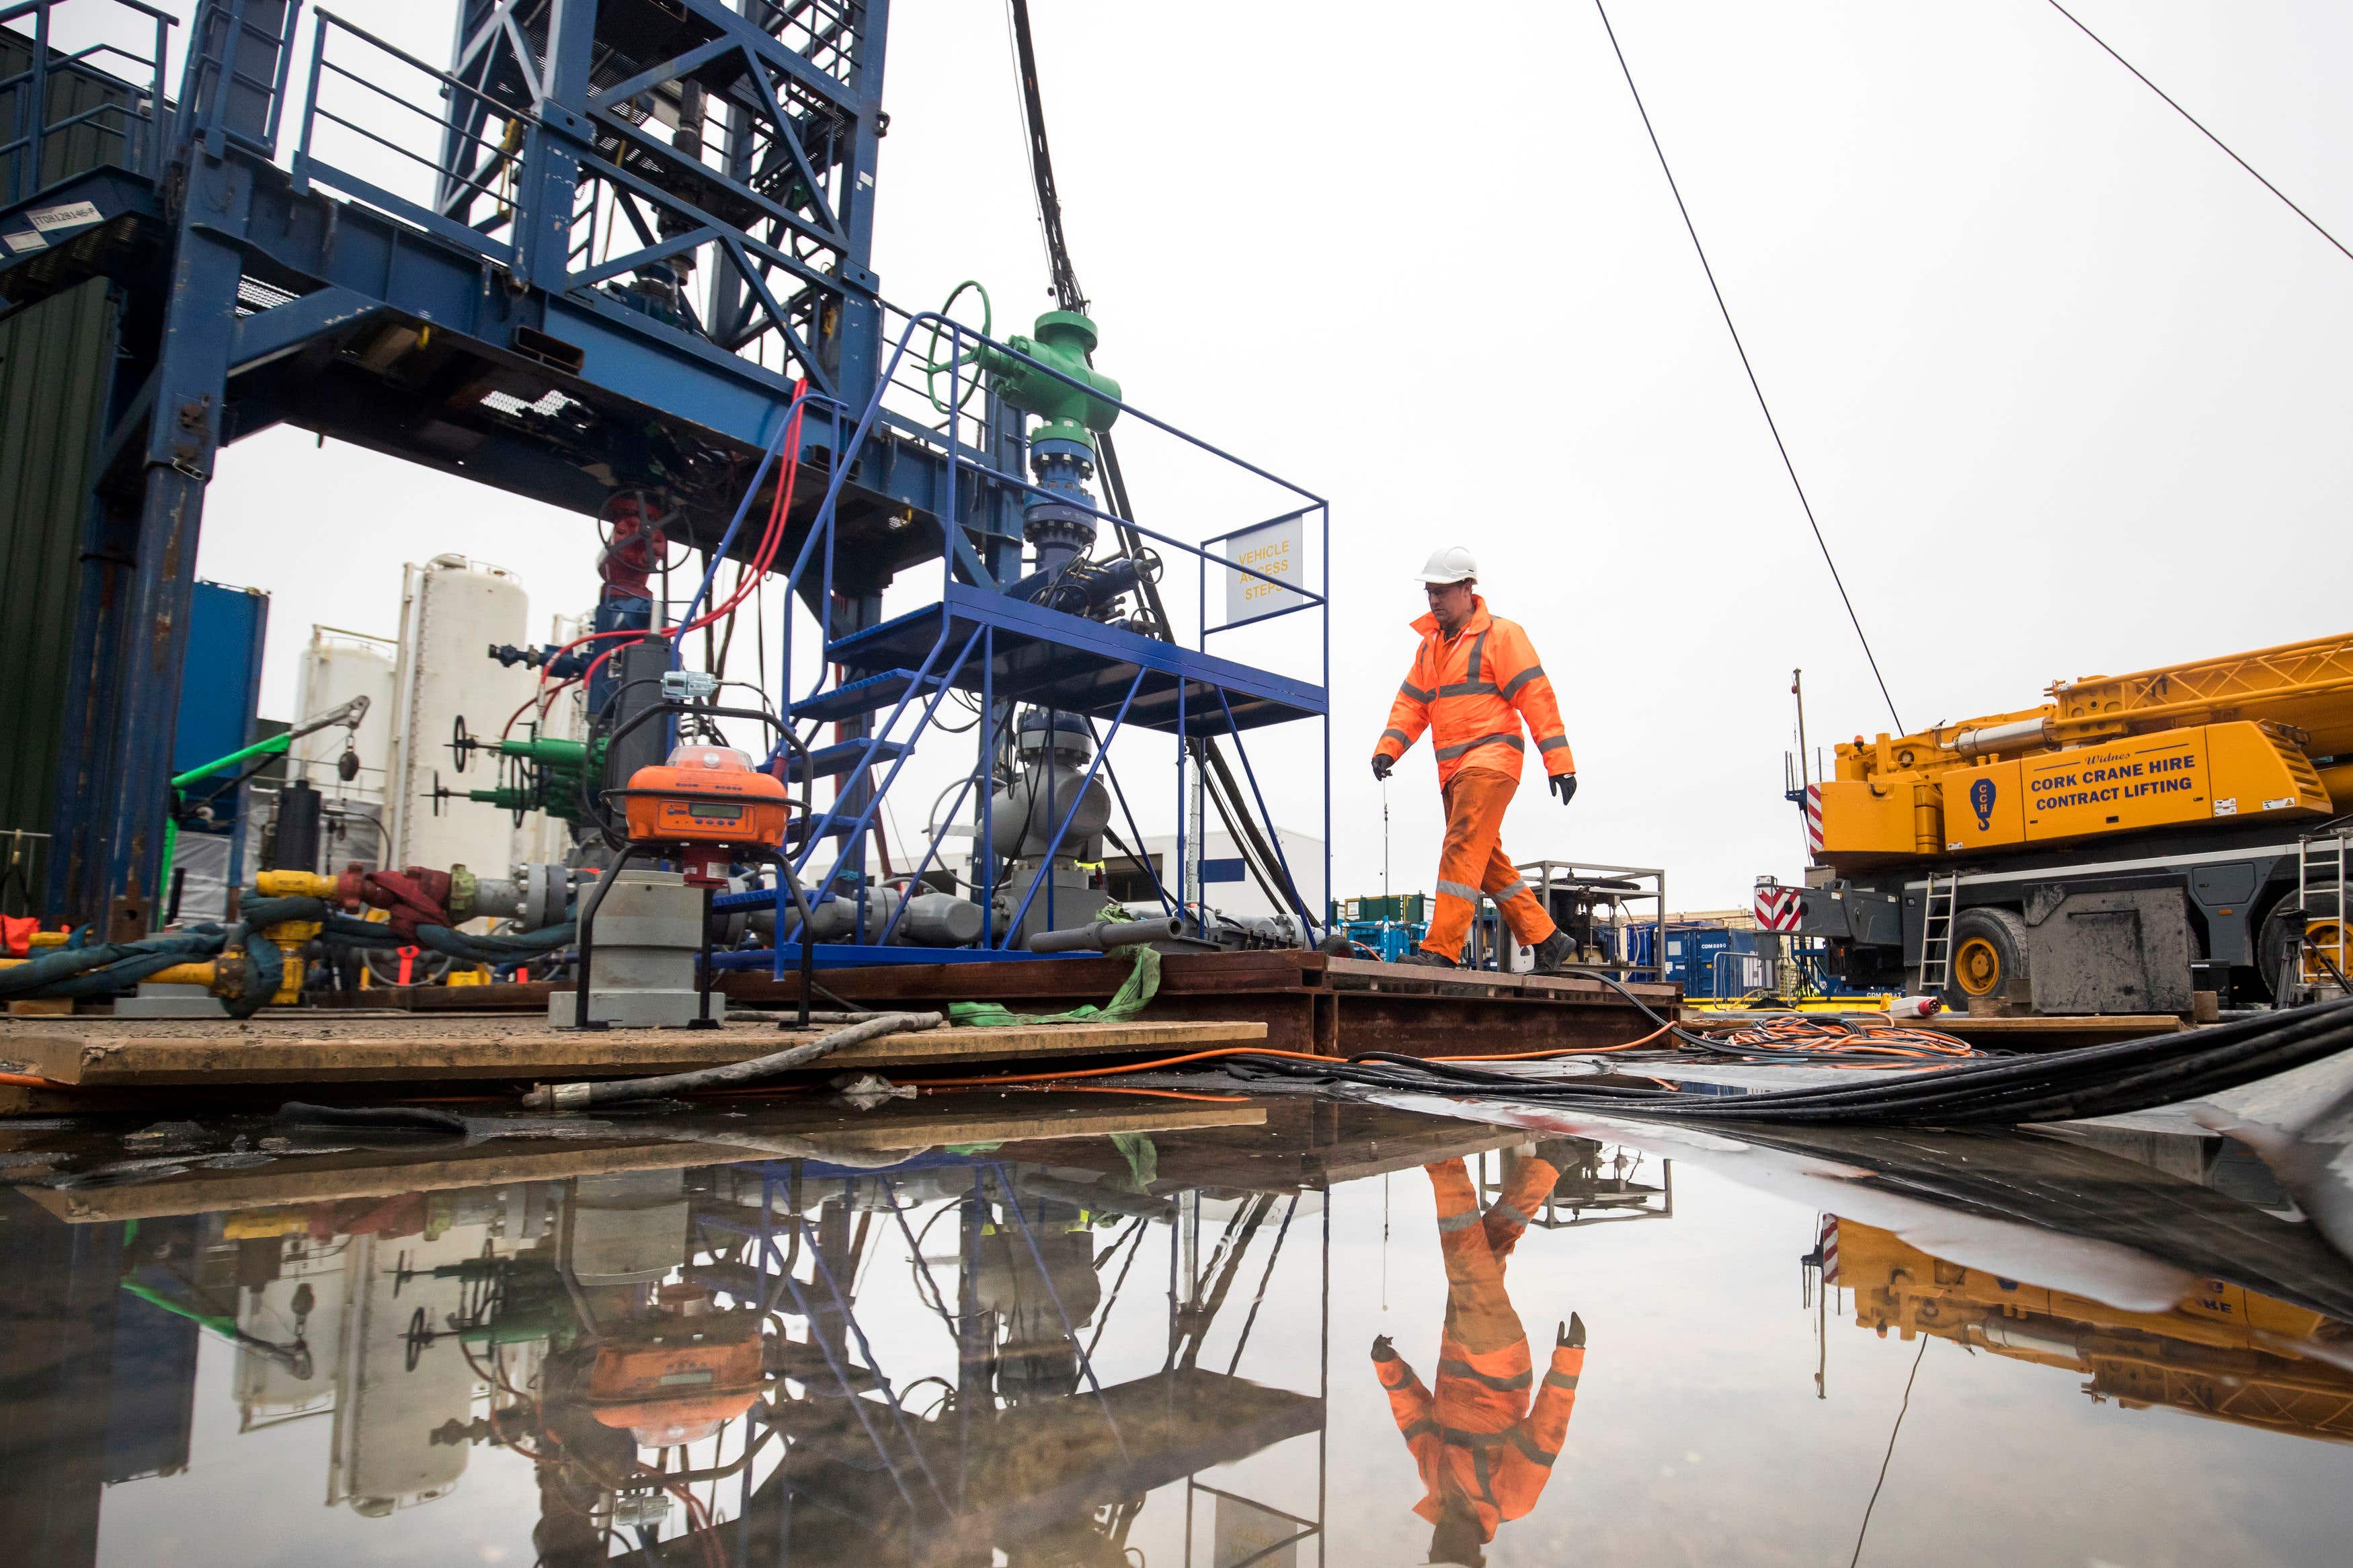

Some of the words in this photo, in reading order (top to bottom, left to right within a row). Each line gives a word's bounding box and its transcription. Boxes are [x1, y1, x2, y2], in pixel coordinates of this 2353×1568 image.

[1238, 540, 1290, 566] VEHICLE
[2031, 774, 2078, 792] CORK
[2082, 763, 2144, 784] CRANE
[2149, 755, 2195, 774] HIRE
[2085, 752, 2130, 766] Widnes
[1979, 784, 1988, 813] CCH
[2036, 787, 2120, 811] CONTRACT
[2124, 776, 2192, 798] LIFTING
